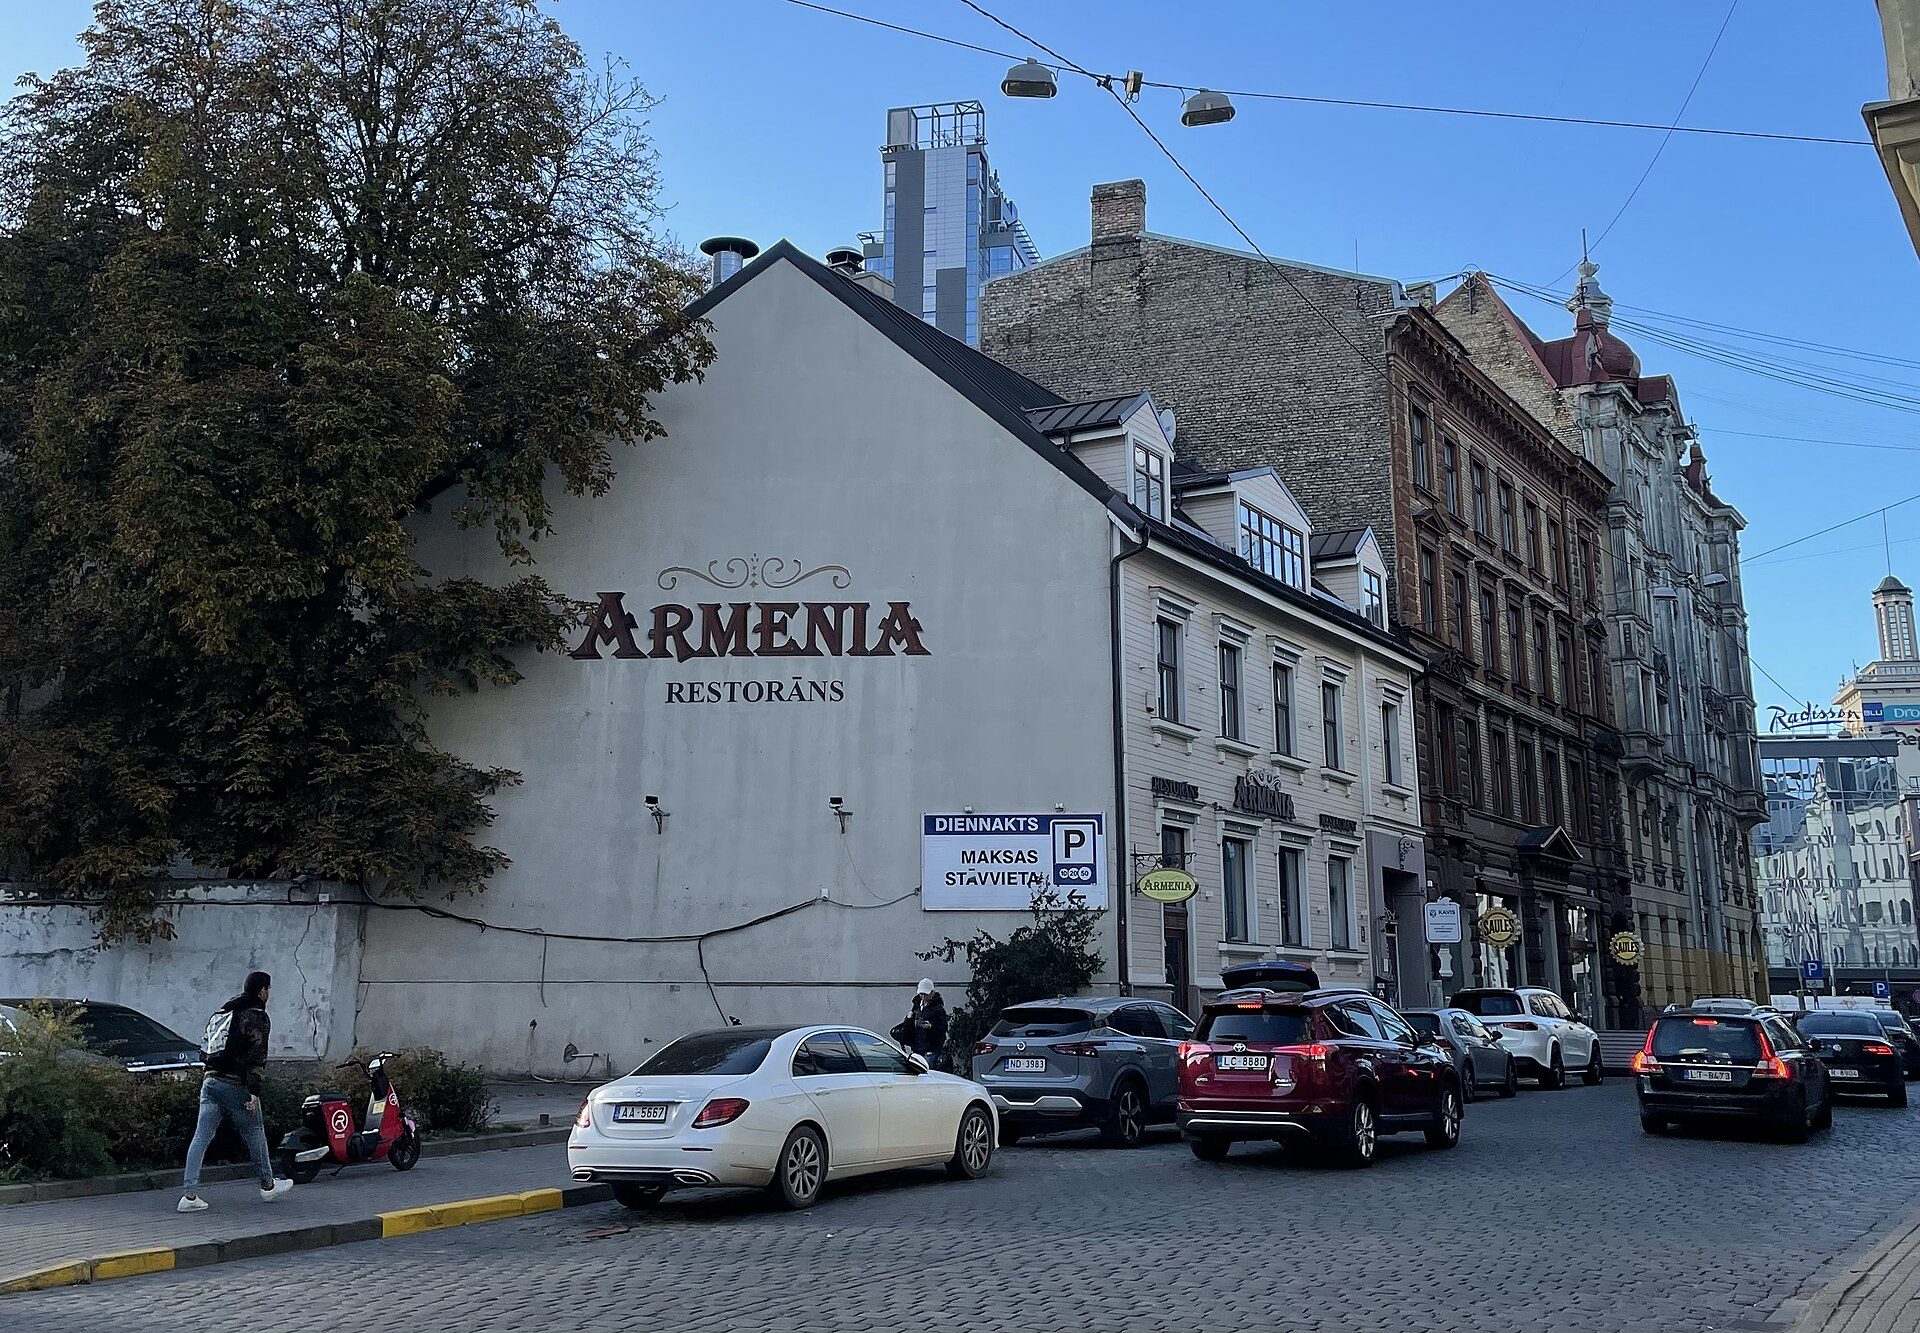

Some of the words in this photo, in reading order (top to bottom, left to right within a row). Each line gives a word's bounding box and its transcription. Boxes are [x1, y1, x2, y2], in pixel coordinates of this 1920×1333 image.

[570, 591, 932, 663] ARMENIA
[665, 676, 844, 704] RESTORĀNS
[1767, 701, 1860, 733] Radisson
[935, 817, 1039, 832] DIENNAKTS
[1064, 829, 1086, 859] P
[961, 850, 1039, 864] MAKSAS
[1143, 879, 1192, 891] ARMENIA
[1483, 919, 1515, 936] SAULES
[1613, 941, 1639, 955] SAULES
[621, 1106, 665, 1118] AA-5667
